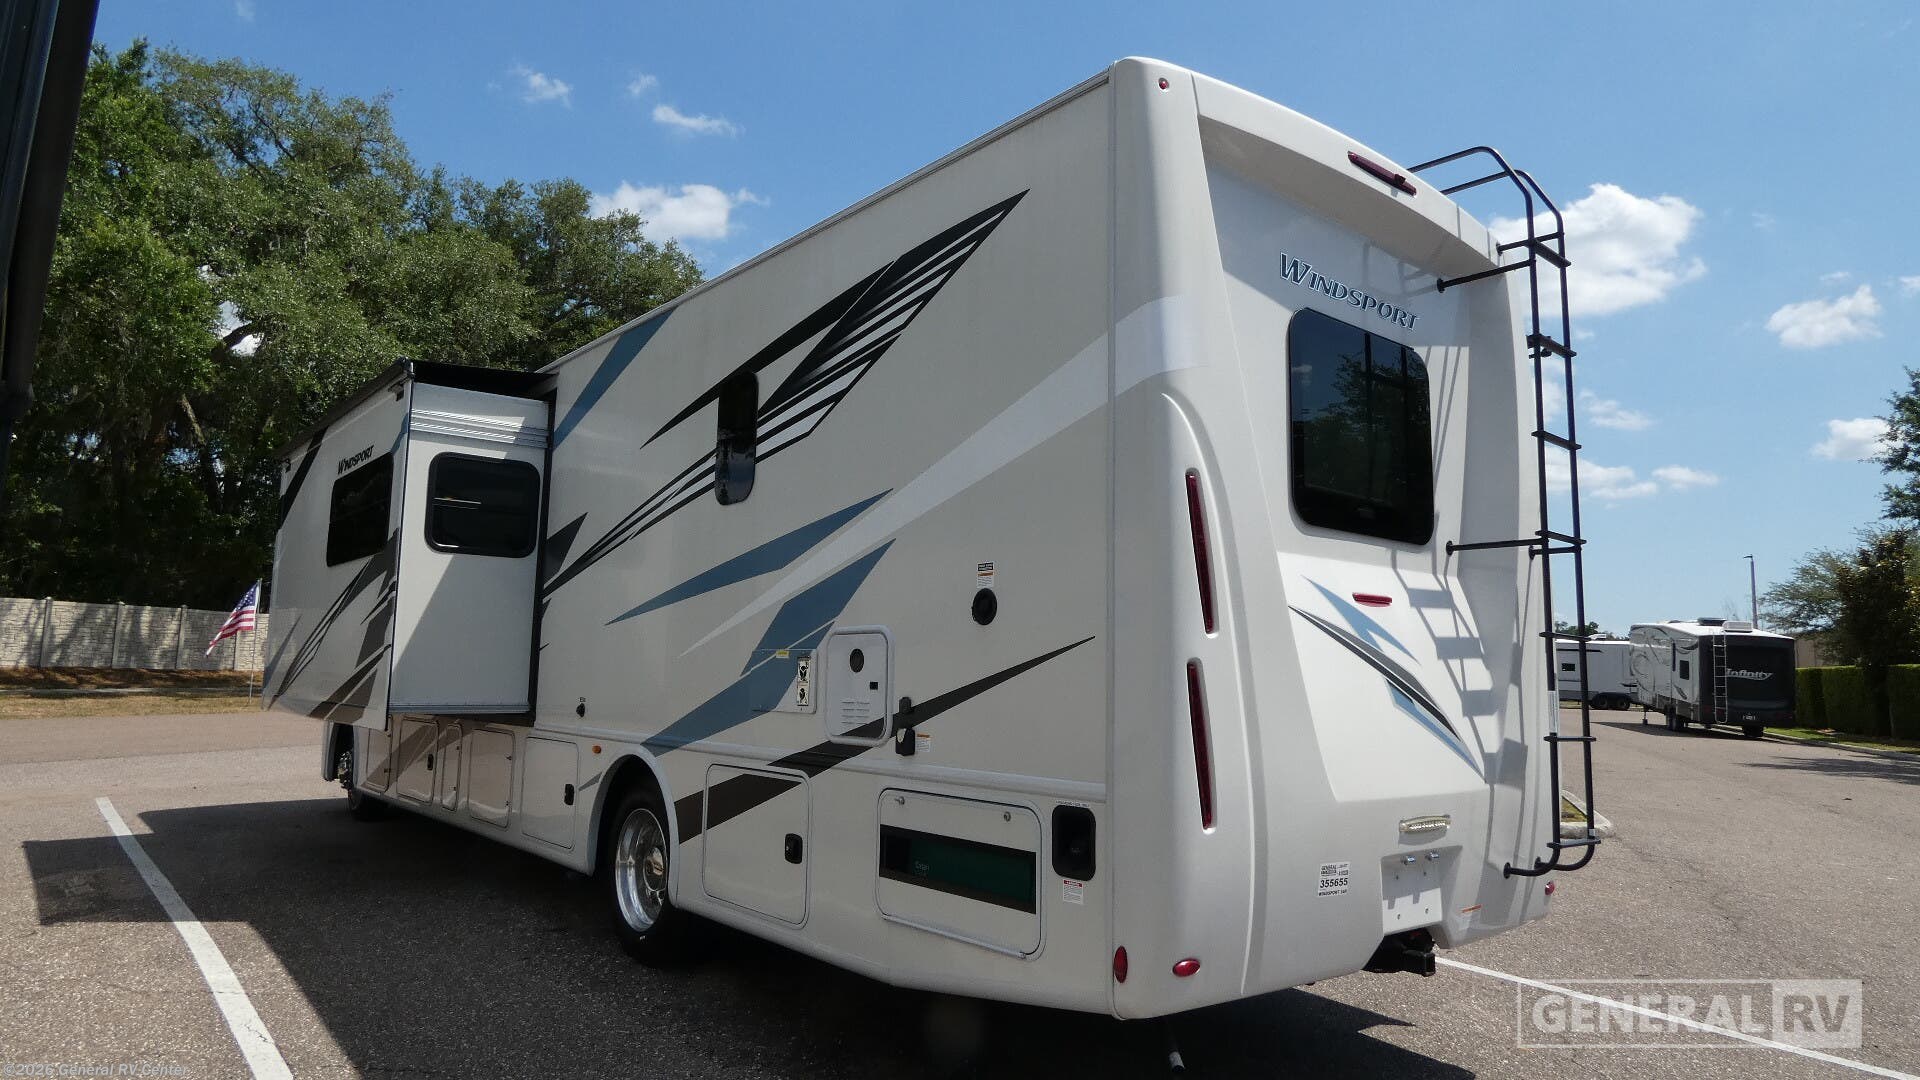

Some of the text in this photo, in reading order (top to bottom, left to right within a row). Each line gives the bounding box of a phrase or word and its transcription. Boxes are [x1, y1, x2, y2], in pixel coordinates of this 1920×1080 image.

[1280, 252, 1420, 330] WINDSPORT
[1726, 668, 1774, 680] Infinity
[1320, 878, 1348, 888] 355655
